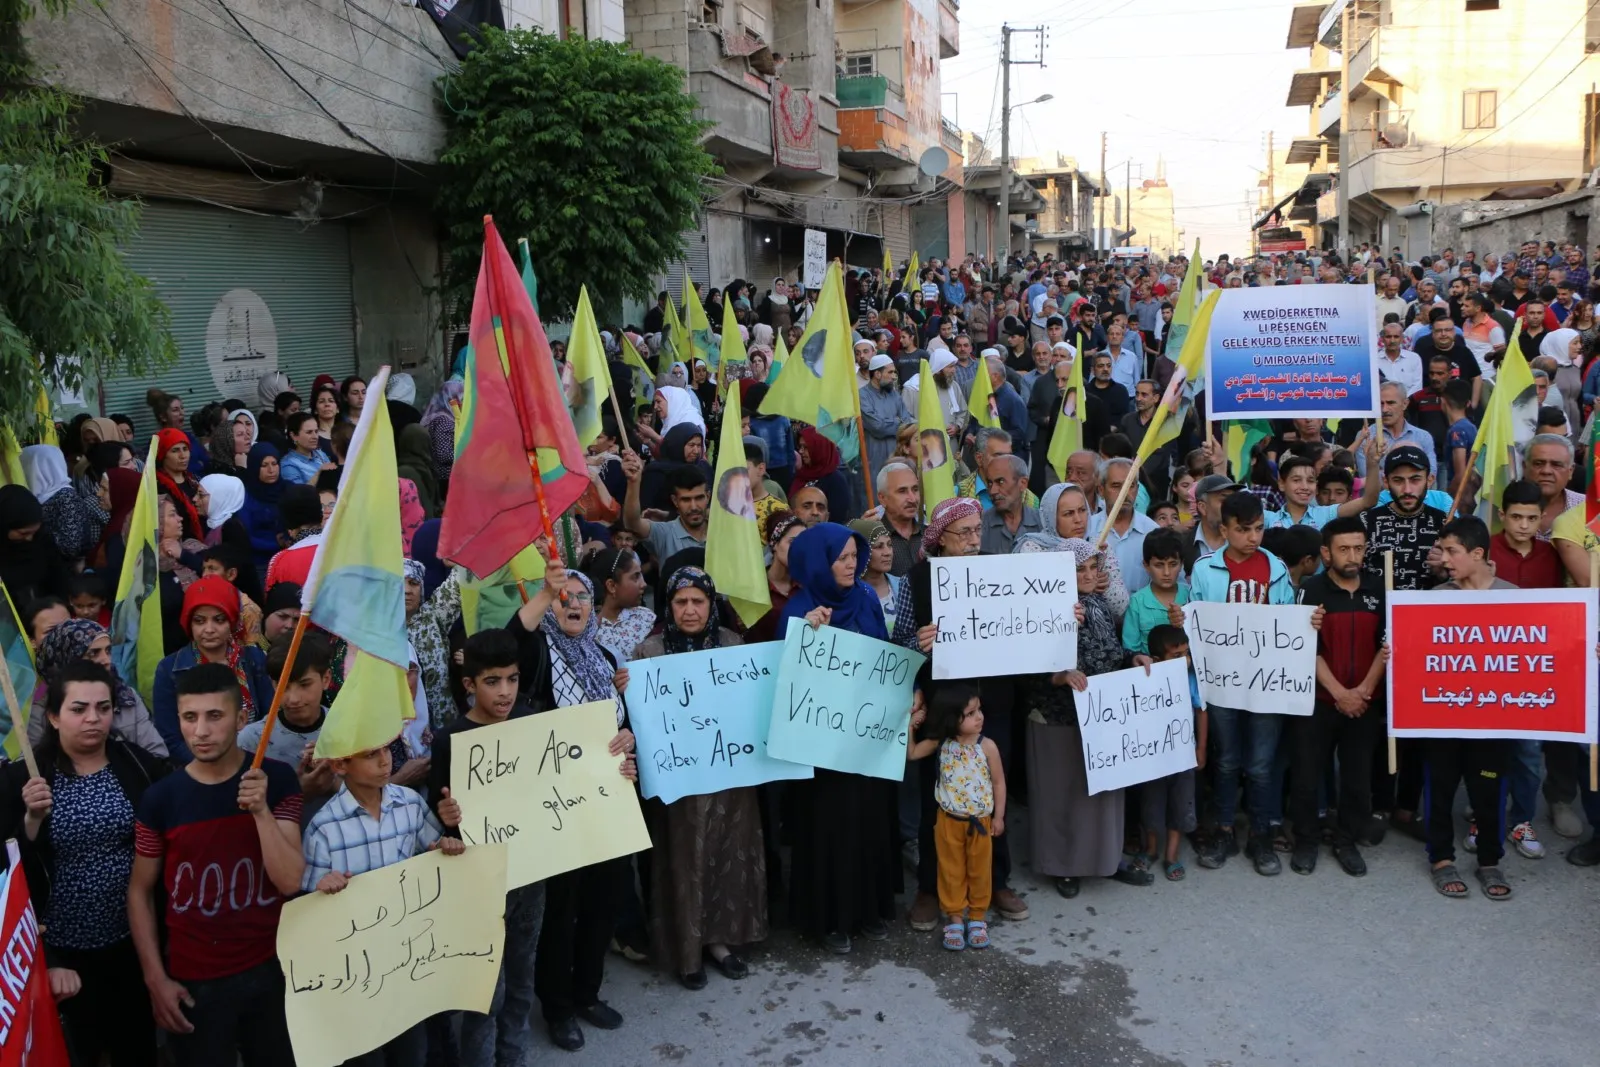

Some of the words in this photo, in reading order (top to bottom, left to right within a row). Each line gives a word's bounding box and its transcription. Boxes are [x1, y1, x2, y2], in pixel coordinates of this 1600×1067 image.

[1258, 323, 1268, 333] LI
[1270, 320, 1327, 334] PÊŞENGÊN
[1222, 336, 1249, 348] GELÊ
[1251, 337, 1281, 347] KURD
[1321, 354, 1334, 364] YE
[1224, 373, 1257, 389] الكردي
[1258, 372, 1291, 386] الشعب
[1293, 372, 1312, 384] قادة
[1313, 372, 1347, 384] مساندة
[1350, 372, 1361, 386] إن
[1277, 387, 1305, 402] قومي
[1306, 387, 1333, 400] واجب
[1334, 388, 1348, 400] هو
[937, 566, 958, 601] Bi
[966, 567, 1015, 598] hêza
[1274, 618, 1305, 650] bo
[1432, 625, 1484, 644] RIYA
[1489, 625, 1547, 644] WAN
[798, 623, 863, 676] Rêber
[868, 650, 909, 686] APO
[1425, 654, 1477, 673] RIYA
[1484, 654, 1519, 673] ME
[1525, 654, 1554, 673] YE
[644, 668, 672, 704] Na
[679, 677, 694, 707] ji
[708, 658, 771, 686] tecrîda
[1248, 667, 1312, 693] Netewî
[1083, 688, 1117, 727] Na
[1477, 694, 1498, 708] هو
[1501, 687, 1555, 708] نهجهم
[789, 682, 845, 733] Vîna
[855, 702, 895, 742] Gelan
[662, 711, 676, 735] li
[710, 729, 755, 768] Apo
[1122, 729, 1159, 762] Rêber
[467, 739, 521, 790] Rêber
[537, 729, 583, 775] Apo
[542, 786, 587, 831] gelan
[172, 857, 279, 917] COOL
